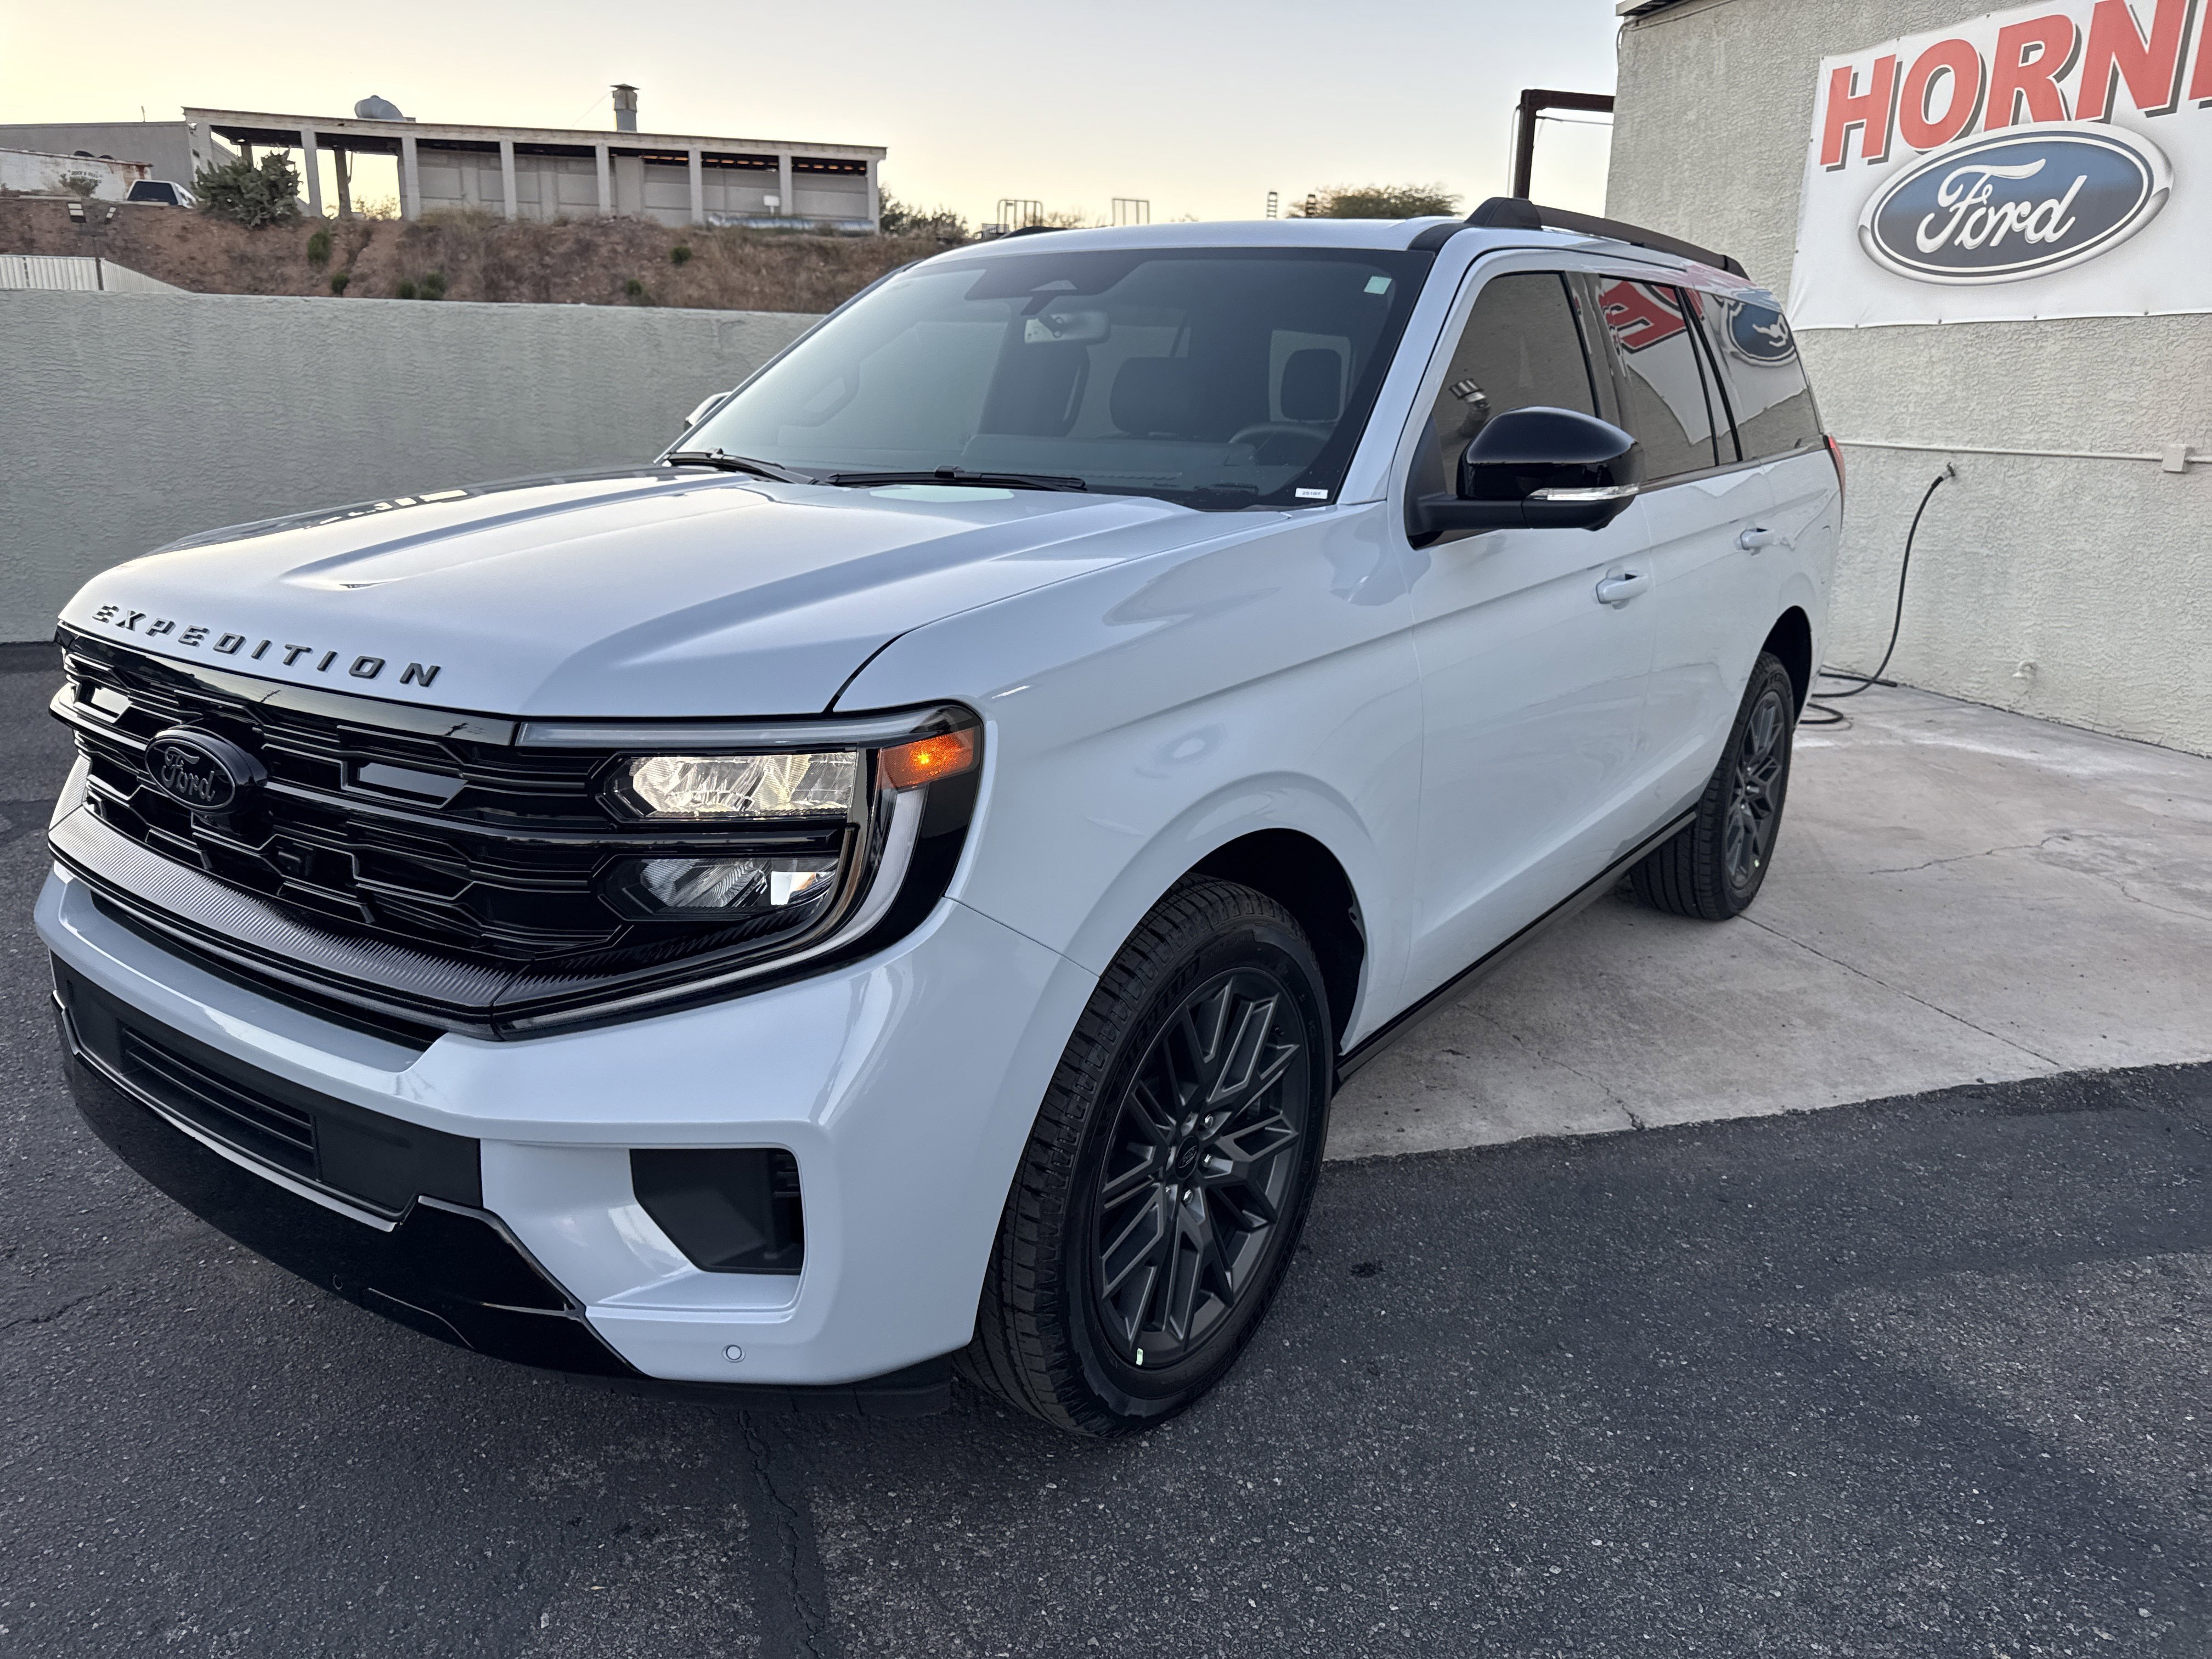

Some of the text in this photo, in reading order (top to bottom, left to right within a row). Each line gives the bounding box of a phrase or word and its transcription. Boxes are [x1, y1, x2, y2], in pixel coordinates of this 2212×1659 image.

[1916, 158, 2088, 254] Ford
[92, 603, 441, 687] EXPEDITION
[162, 746, 216, 803] Ford
